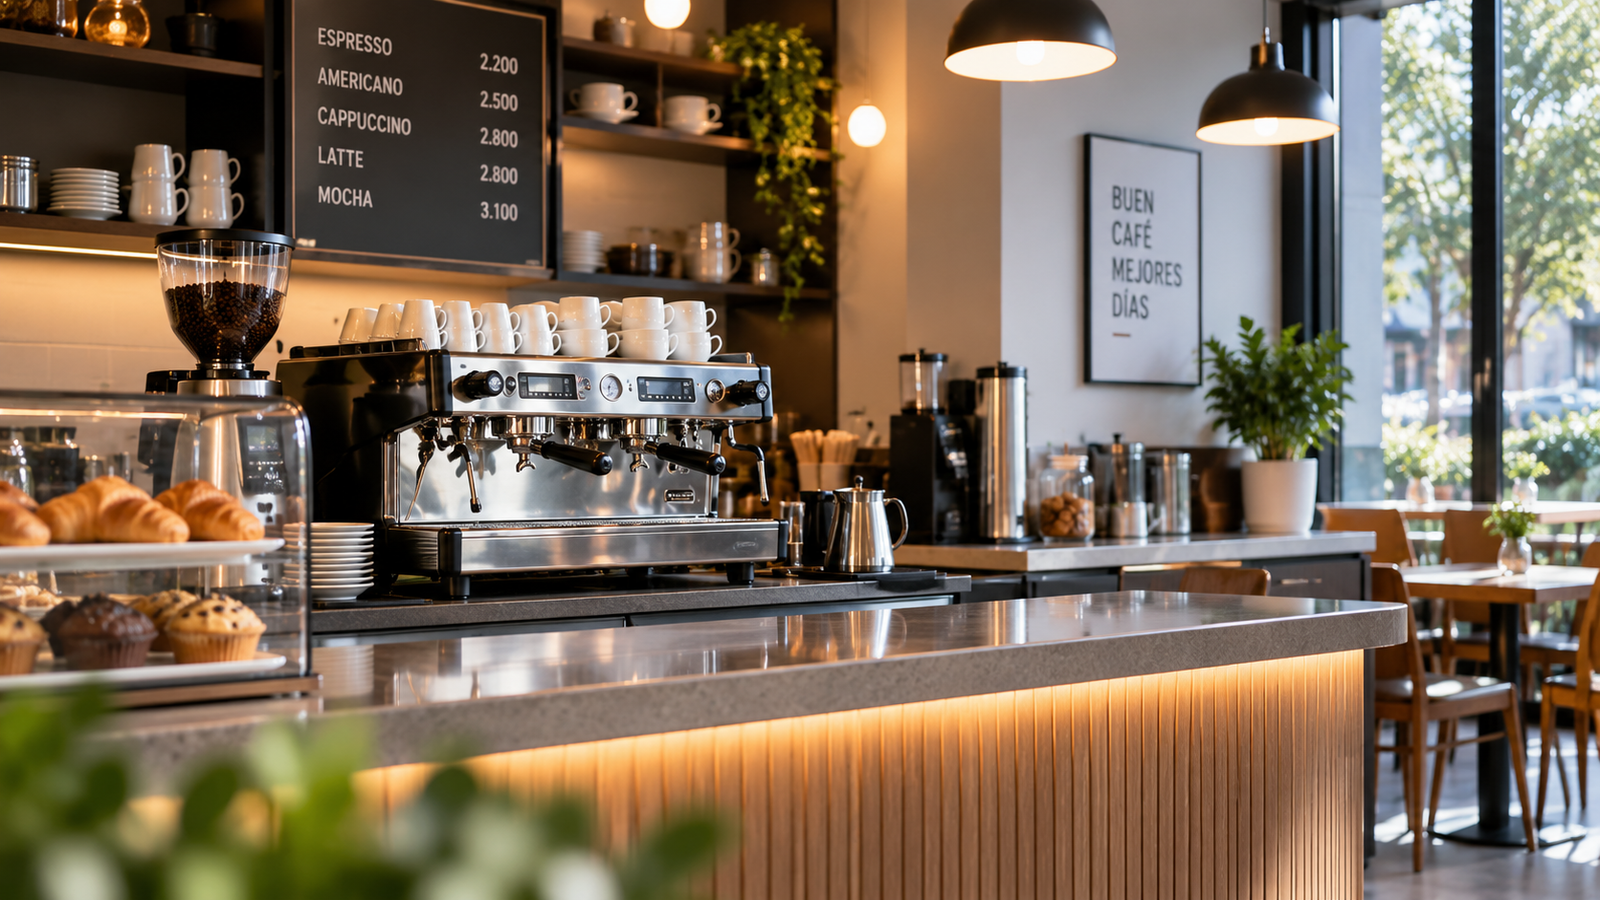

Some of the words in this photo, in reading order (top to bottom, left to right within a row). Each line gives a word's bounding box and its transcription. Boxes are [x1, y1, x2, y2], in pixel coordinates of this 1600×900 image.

[317, 27, 393, 56] ESPRESSO
[480, 52, 518, 75] 2.200
[317, 66, 403, 96] AMERICANO
[480, 90, 518, 112] 2.500
[317, 106, 412, 136] CAPPUCCINO
[480, 127, 518, 149] 2.800
[318, 146, 364, 169] LATTE
[480, 164, 518, 185] 2.800
[318, 185, 373, 208] MOCHA
[480, 201, 518, 222] 3.100
[1111, 185, 1155, 215] BUEN
[1111, 219, 1153, 249] CAFÉ
[1111, 256, 1183, 287] MEJORES
[1111, 288, 1150, 320] DÍAS
